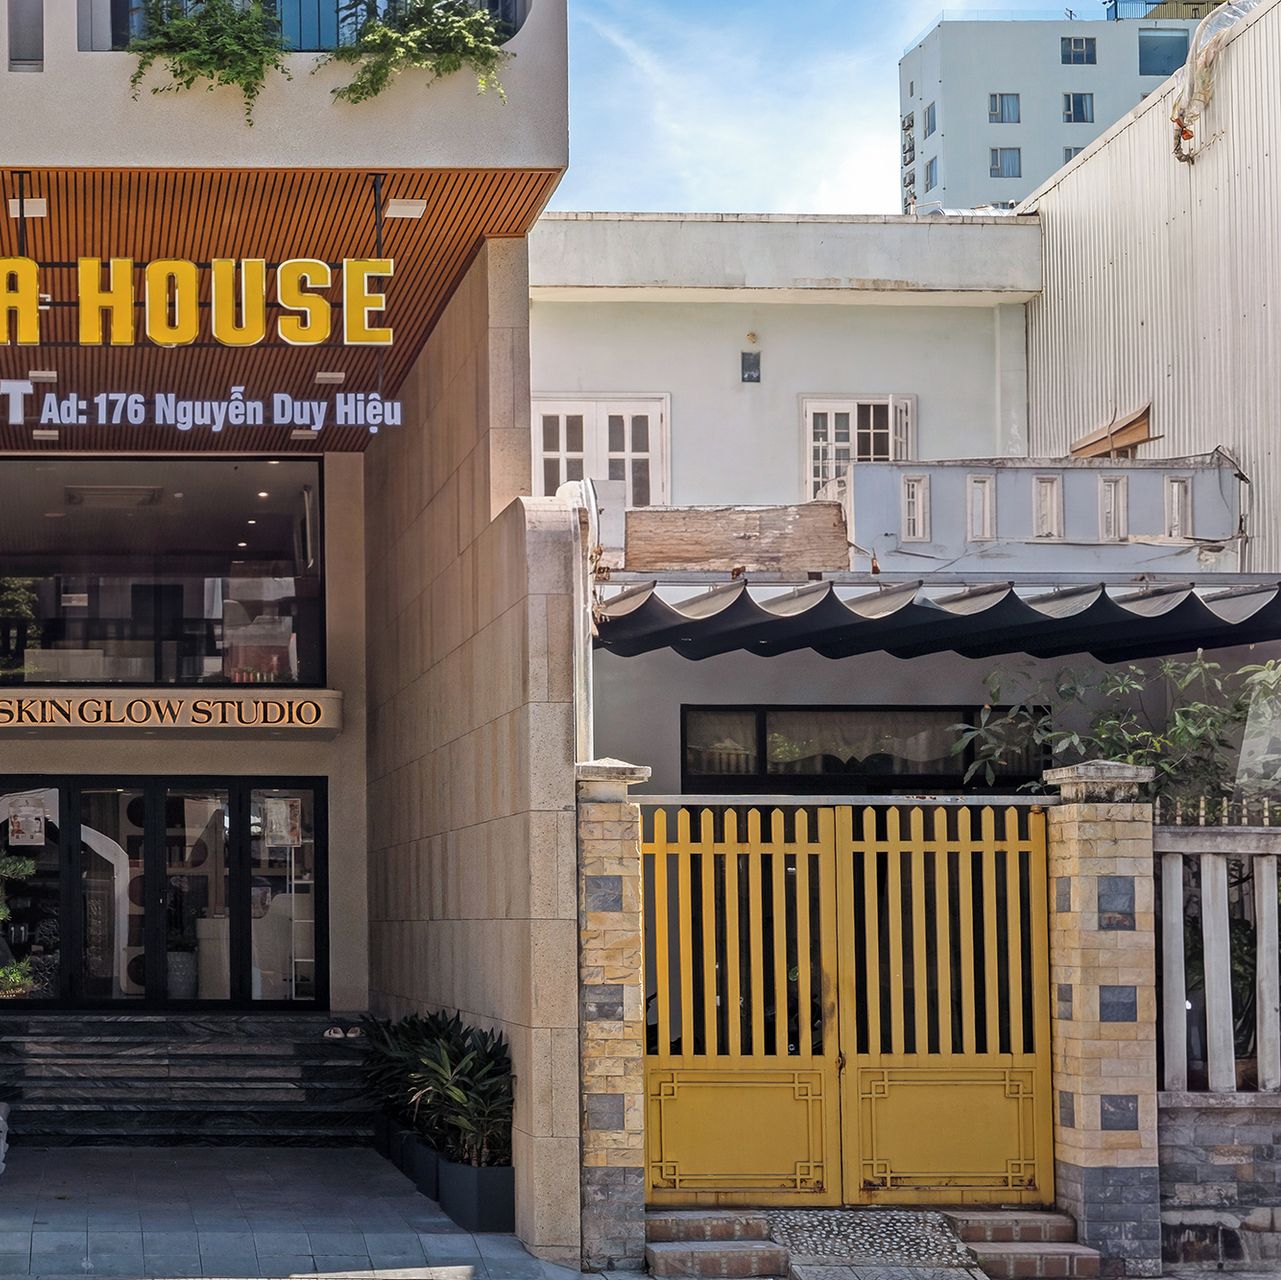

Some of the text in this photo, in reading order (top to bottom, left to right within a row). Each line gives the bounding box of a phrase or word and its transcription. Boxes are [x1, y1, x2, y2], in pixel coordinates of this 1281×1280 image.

[77, 256, 395, 348] HOUSE
[39, 392, 87, 425] Ad:
[94, 393, 146, 425] 176
[154, 386, 263, 432] Nguyễn
[272, 392, 328, 431] Duy
[335, 391, 402, 434] Hiệu
[78, 699, 184, 724] GLOW
[191, 700, 322, 725] STUDIO
